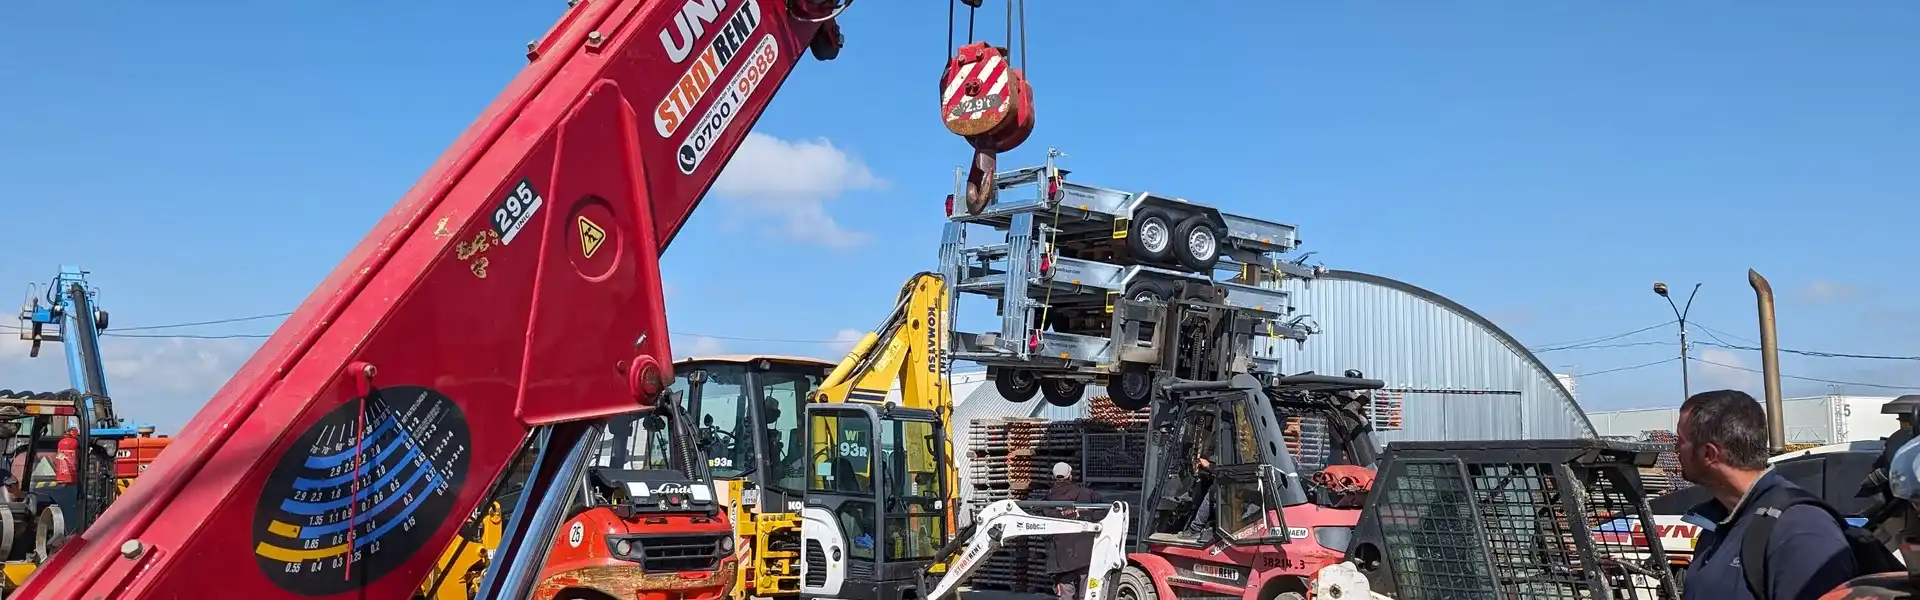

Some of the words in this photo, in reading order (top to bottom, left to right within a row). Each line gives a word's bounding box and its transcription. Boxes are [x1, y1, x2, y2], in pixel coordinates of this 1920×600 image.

[659, 0, 726, 63] UN
[658, 0, 757, 133] STROYRENT
[694, 102, 731, 152] 0700
[738, 44, 775, 97] 9988
[496, 182, 533, 233] 295
[515, 212, 531, 230] UNIC
[928, 306, 936, 373] KOMATSU
[1843, 404, 1851, 417] 5
[294, 490, 307, 501] 2.9
[311, 492, 322, 502] 2.3
[331, 488, 341, 499] 1.8
[363, 475, 372, 487] 1.2
[376, 465, 386, 478] 1.0
[404, 437, 415, 450] 0.9
[330, 466, 341, 477] 2.9
[344, 461, 354, 473] 2.5
[393, 422, 403, 434] 1.9
[840, 442, 867, 456] 93R
[304, 539, 319, 549] 0.85
[333, 535, 343, 545] 0.6
[366, 520, 376, 533] 0.4
[403, 492, 414, 506] 0.3
[425, 466, 437, 482] 0.27
[310, 515, 323, 526] 1.35
[329, 513, 339, 523] 1.1
[342, 508, 352, 520] 0.9
[362, 499, 371, 512] 0.7
[374, 491, 384, 505] 0.6
[390, 479, 400, 492] 0.5
[414, 452, 427, 468] 0.43
[650, 482, 693, 494] Linde
[788, 501, 804, 510] KO
[285, 562, 301, 573] 0.55
[311, 562, 322, 572] 0.4
[332, 557, 343, 569] 0.3
[370, 541, 380, 554] 0.2
[403, 517, 416, 531] 0.15
[437, 481, 449, 496] 0.13
[572, 526, 581, 542] 25
[1026, 522, 1046, 530] Bobcat
